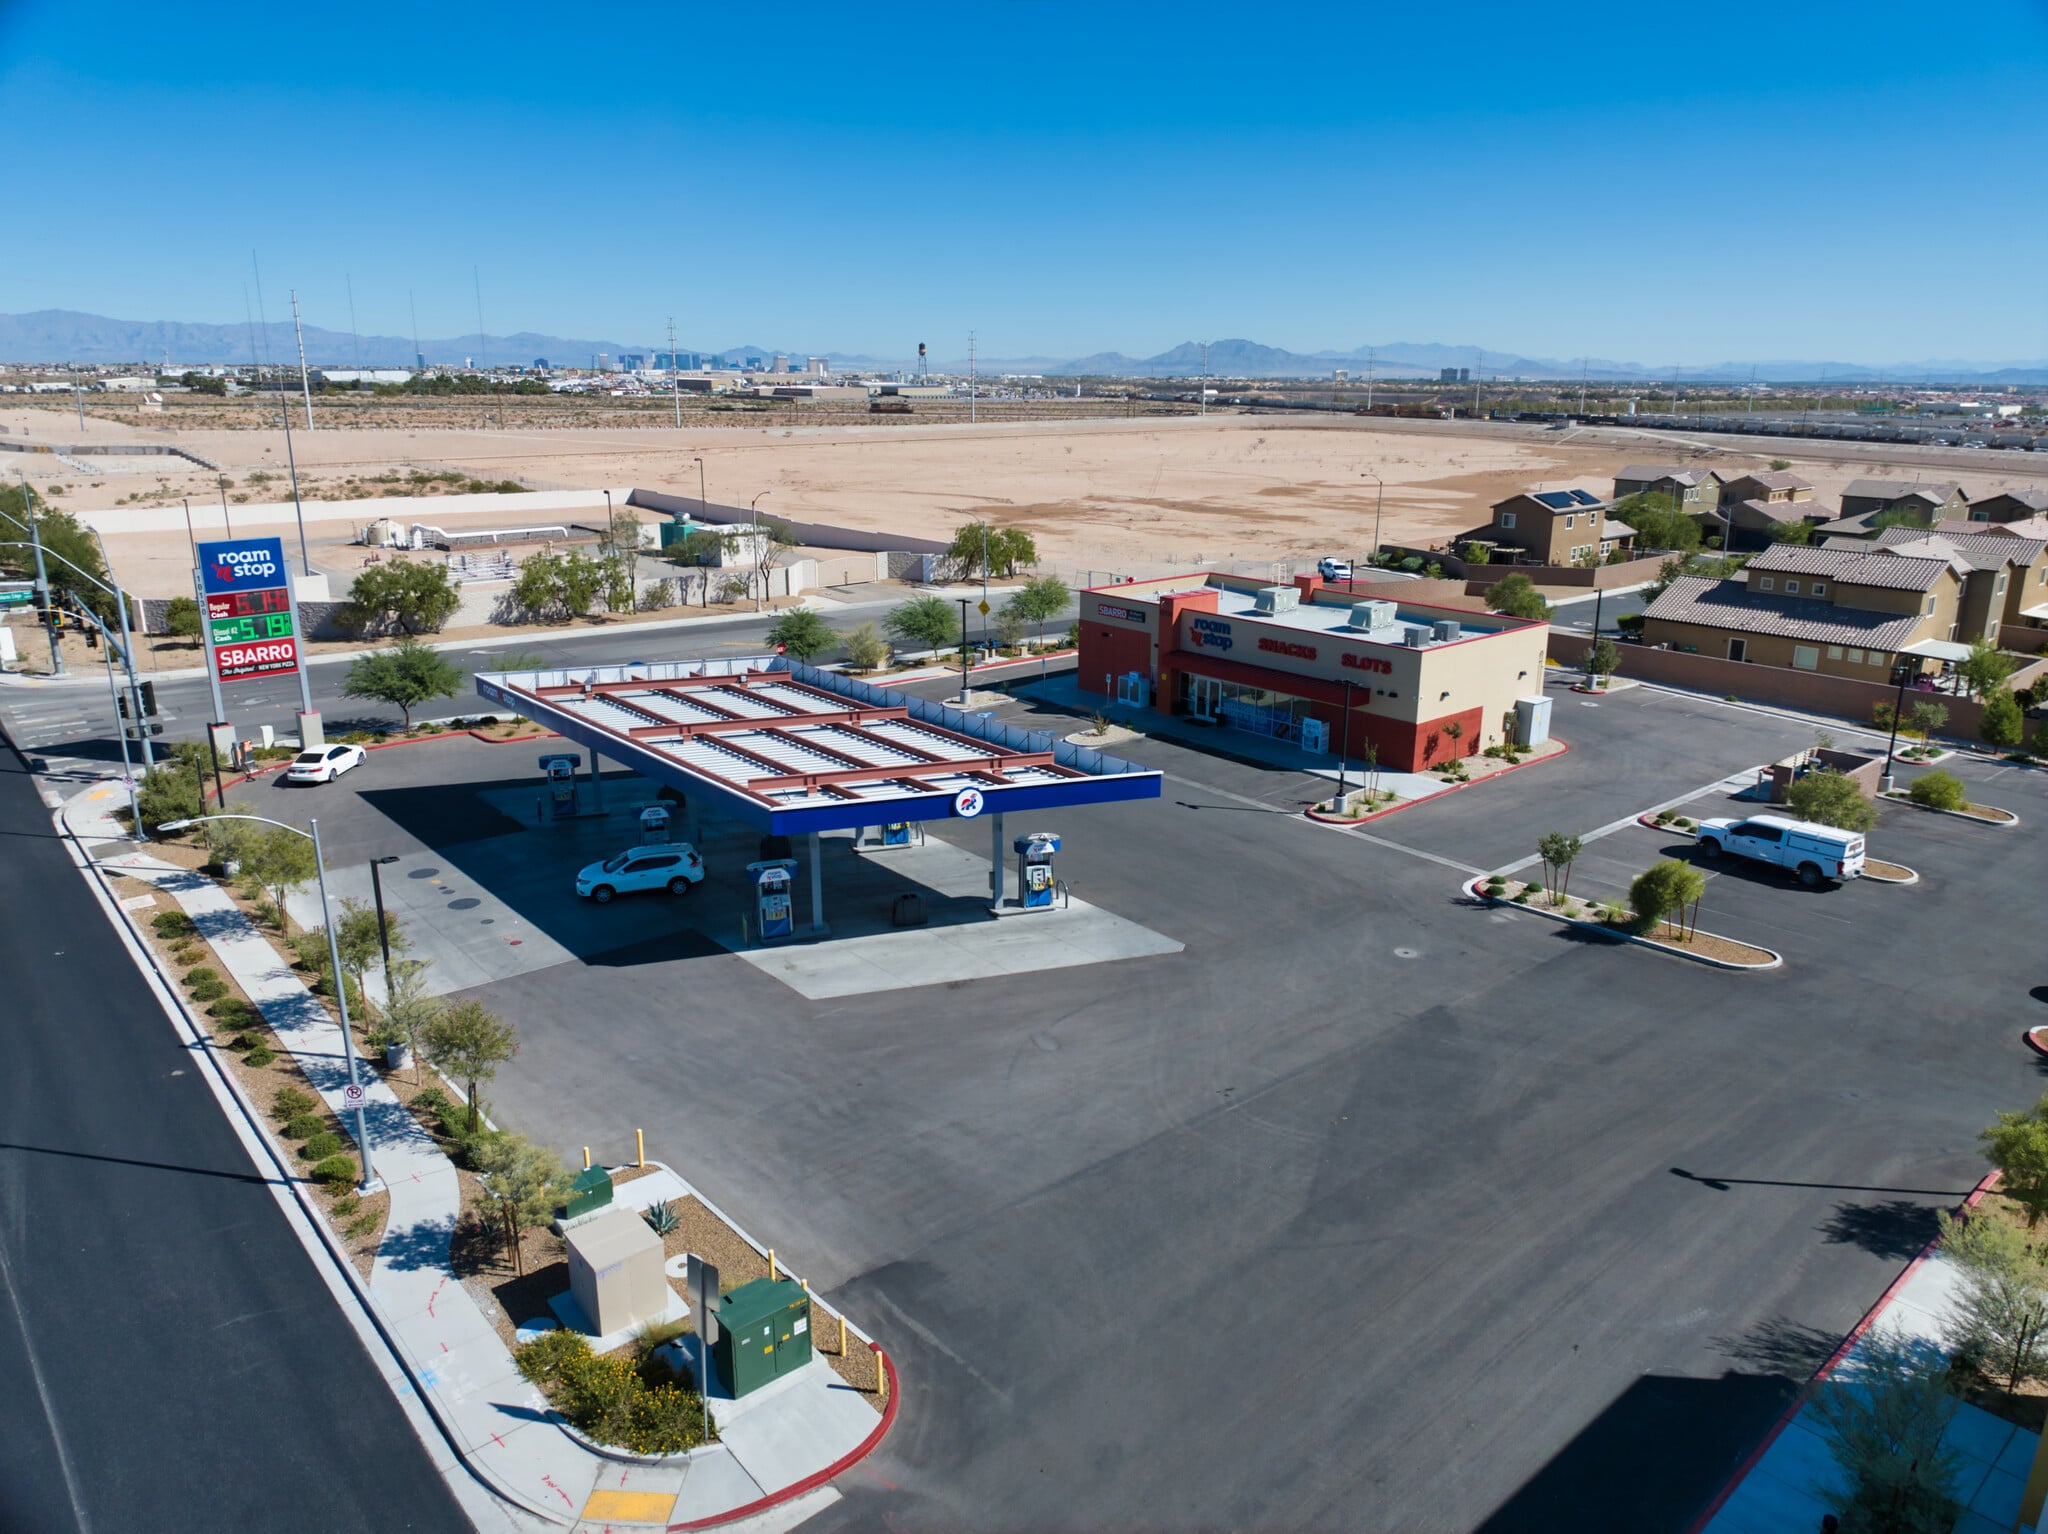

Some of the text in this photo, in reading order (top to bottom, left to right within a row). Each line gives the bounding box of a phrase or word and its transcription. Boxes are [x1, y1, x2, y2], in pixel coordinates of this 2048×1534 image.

[218, 550, 271, 564] roam
[233, 563, 276, 578] stop
[209, 602, 230, 612] Regular
[1099, 605, 1127, 619] SBARRO
[1194, 618, 1231, 635] roam
[1202, 633, 1233, 651] stop
[1258, 637, 1317, 661] SNACKS
[220, 644, 293, 666] SBARRO
[1341, 653, 1393, 675] SLOTS
